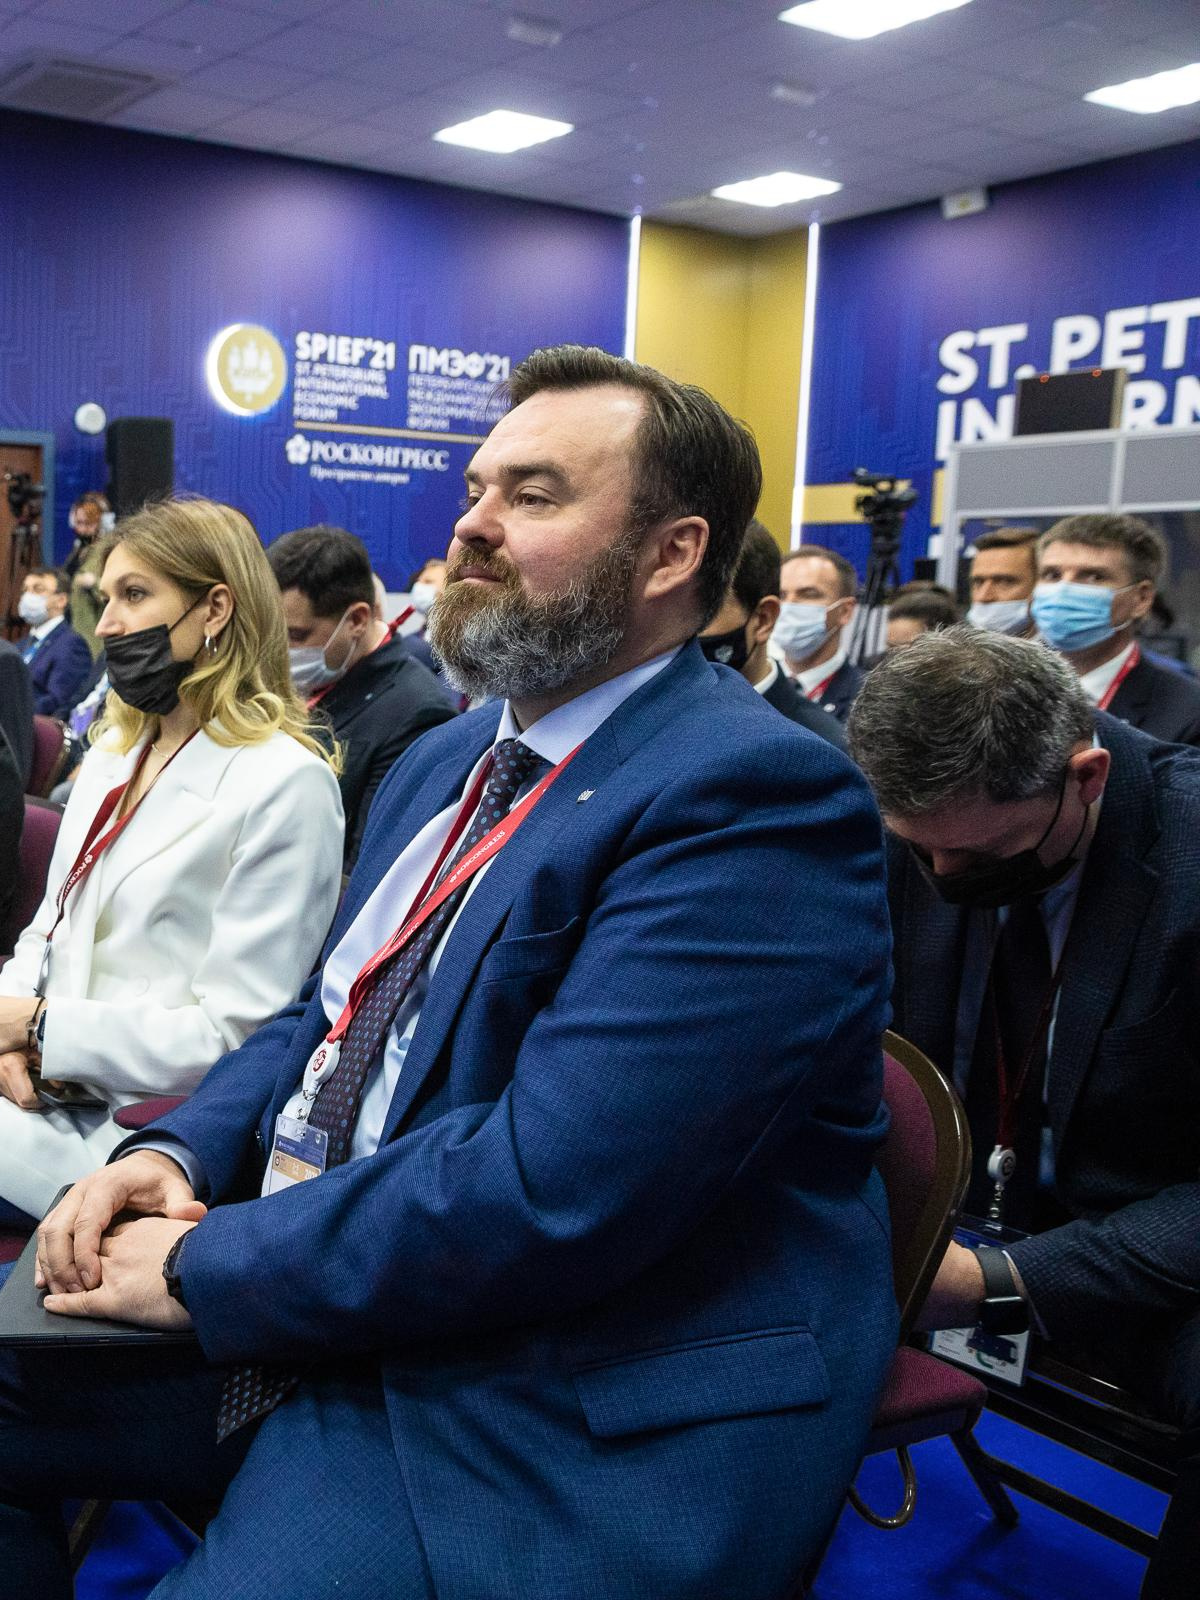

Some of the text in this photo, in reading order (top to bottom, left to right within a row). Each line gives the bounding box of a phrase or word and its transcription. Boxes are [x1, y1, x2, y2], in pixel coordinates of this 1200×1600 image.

[295, 331, 396, 370] SPIEF'21
[936, 322, 1037, 395] ST.
[311, 440, 450, 471] РОСКОНГРЕСС
